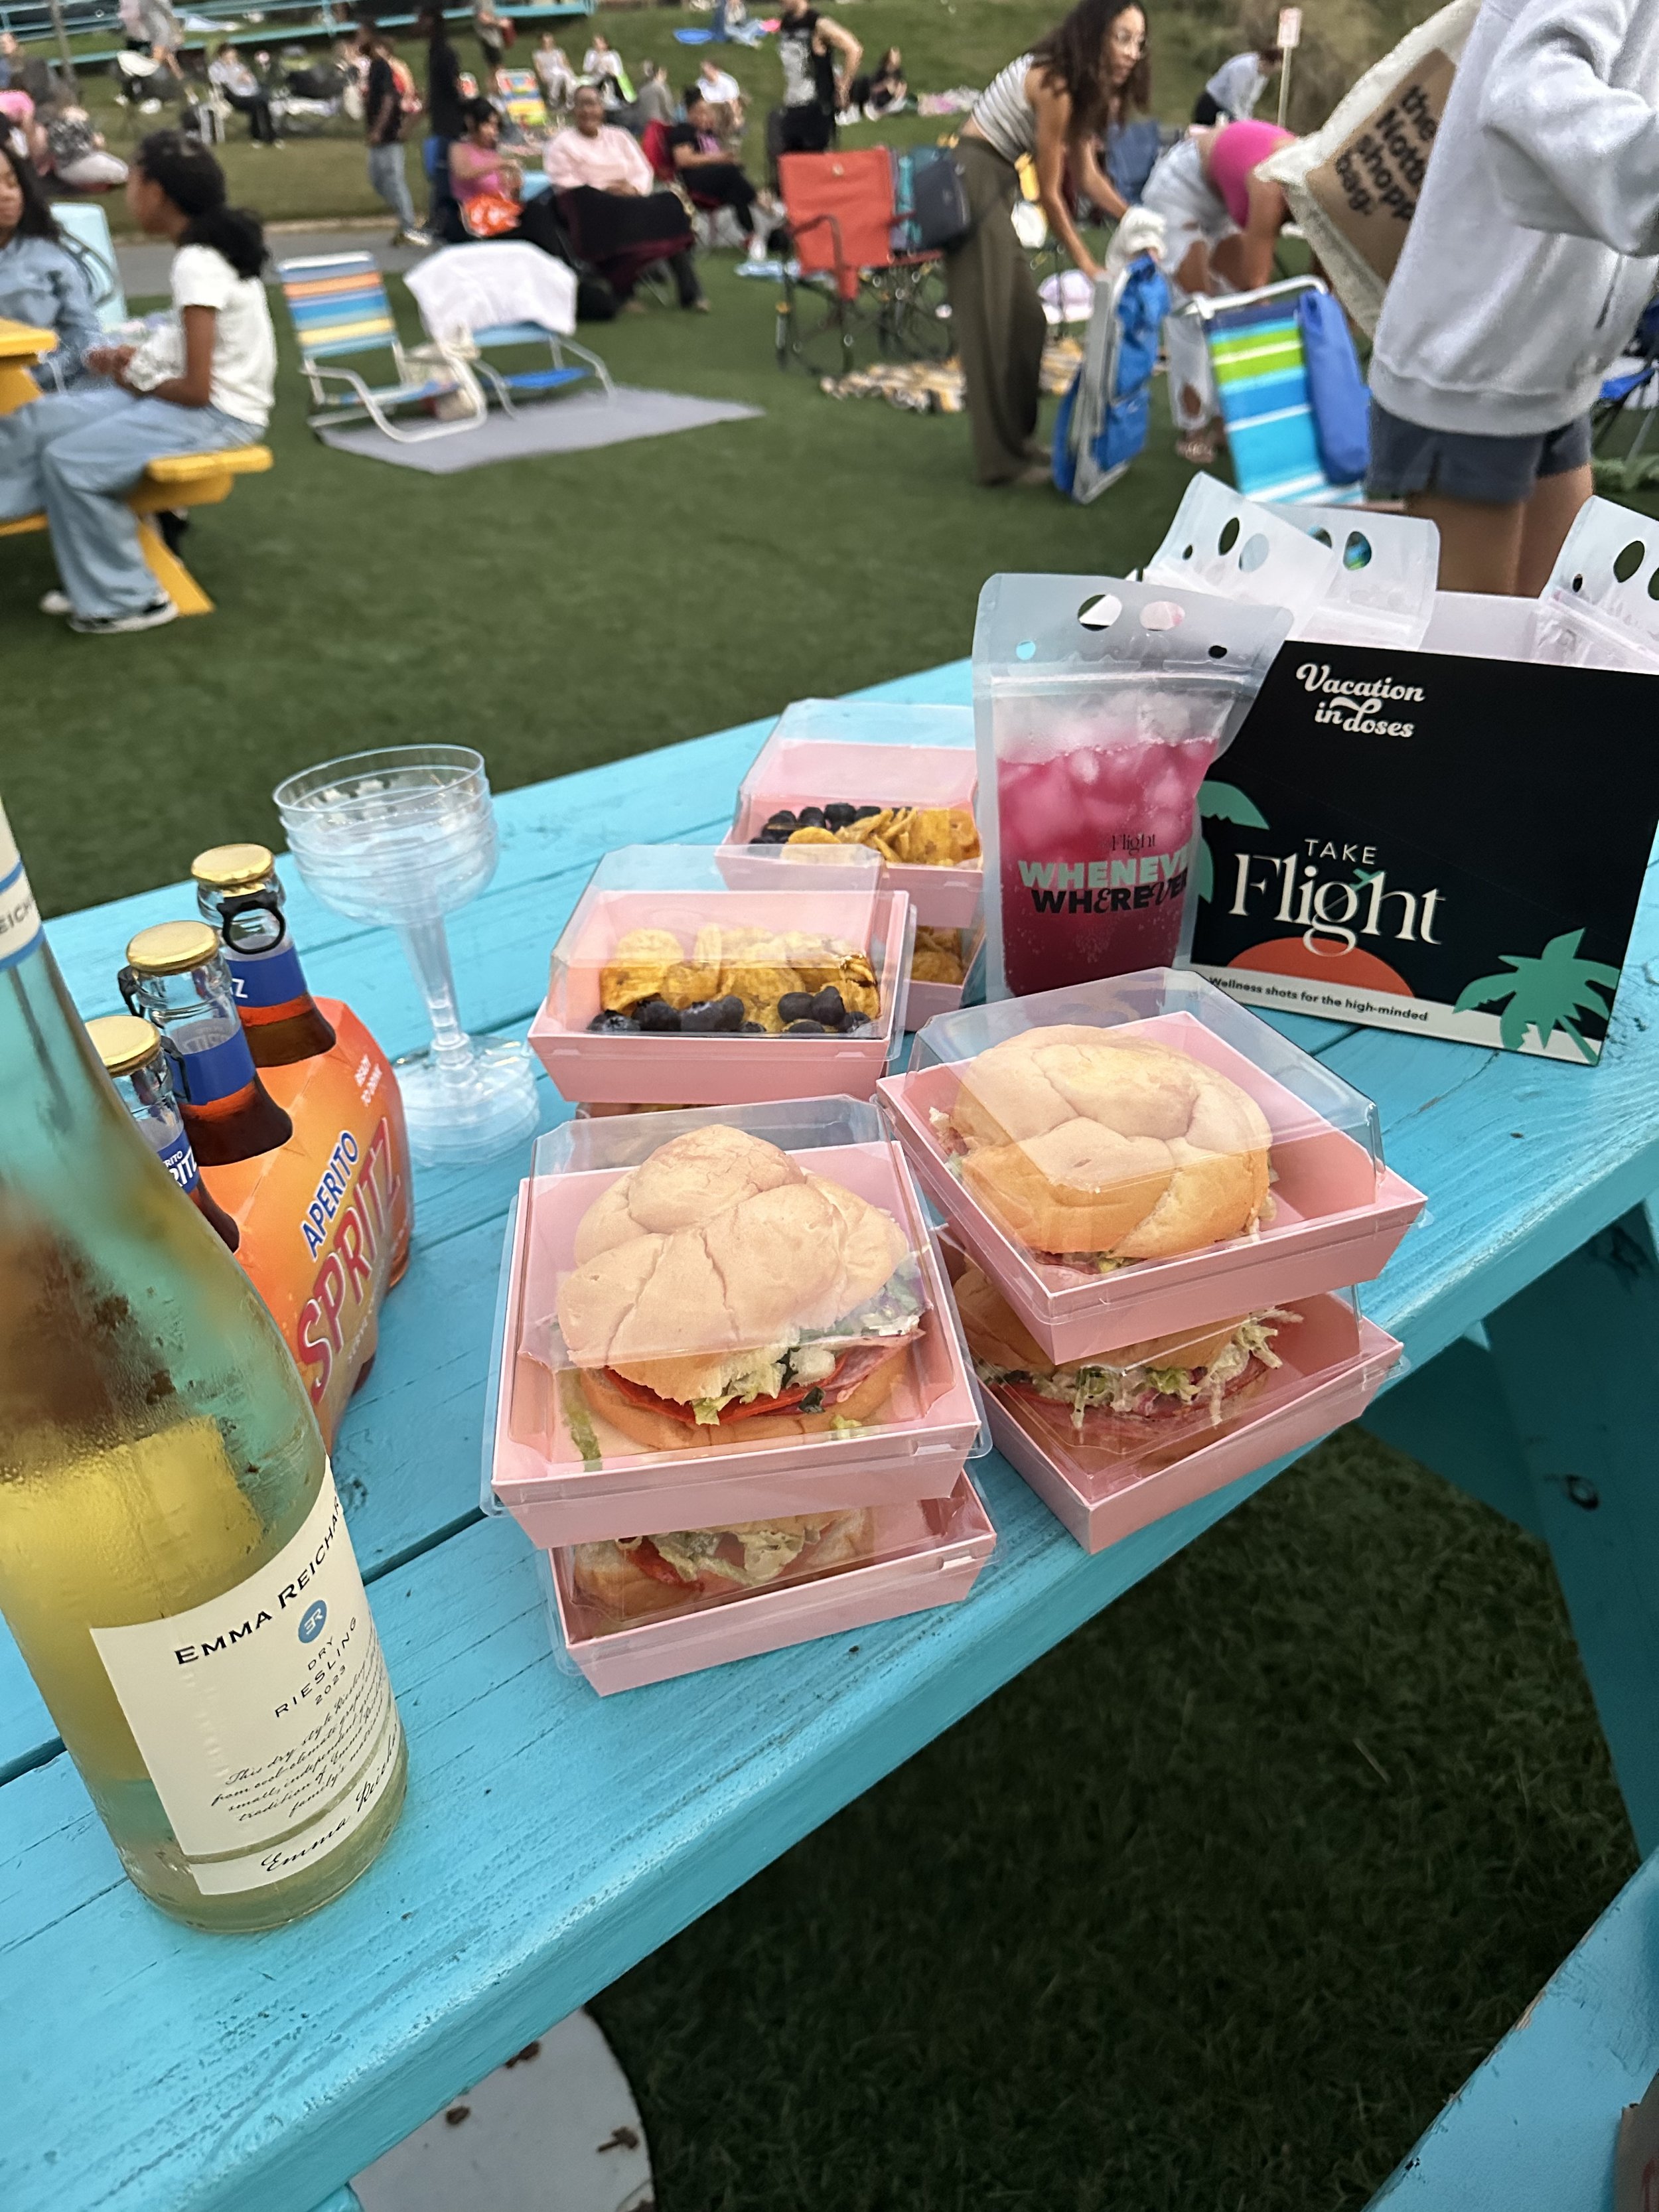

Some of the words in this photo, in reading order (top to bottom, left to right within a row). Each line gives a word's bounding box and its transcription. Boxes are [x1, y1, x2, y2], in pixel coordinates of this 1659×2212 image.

[1295, 663, 1426, 702] Vacation
[1315, 701, 1344, 724] in
[1329, 697, 1415, 738] doses
[1112, 833, 1156, 855] Flight
[1305, 838, 1378, 865] TAKE
[1228, 853, 1447, 958] Flight
[1209, 976, 1263, 994] Wellness
[1265, 986, 1298, 999] shots
[1300, 991, 1319, 1003] for
[1322, 995, 1342, 1007] the
[1345, 998, 1429, 1022] high-minded
[301, 1131, 358, 1260] APERITO
[297, 1118, 401, 1405] SPRITZ
[175, 1611, 273, 1664] EMMA
[277, 1489, 340, 1609] REICHAR
[275, 1617, 356, 1718] RIESLING
[307, 1636, 332, 1670] DRY
[315, 1664, 345, 1706] 2023
